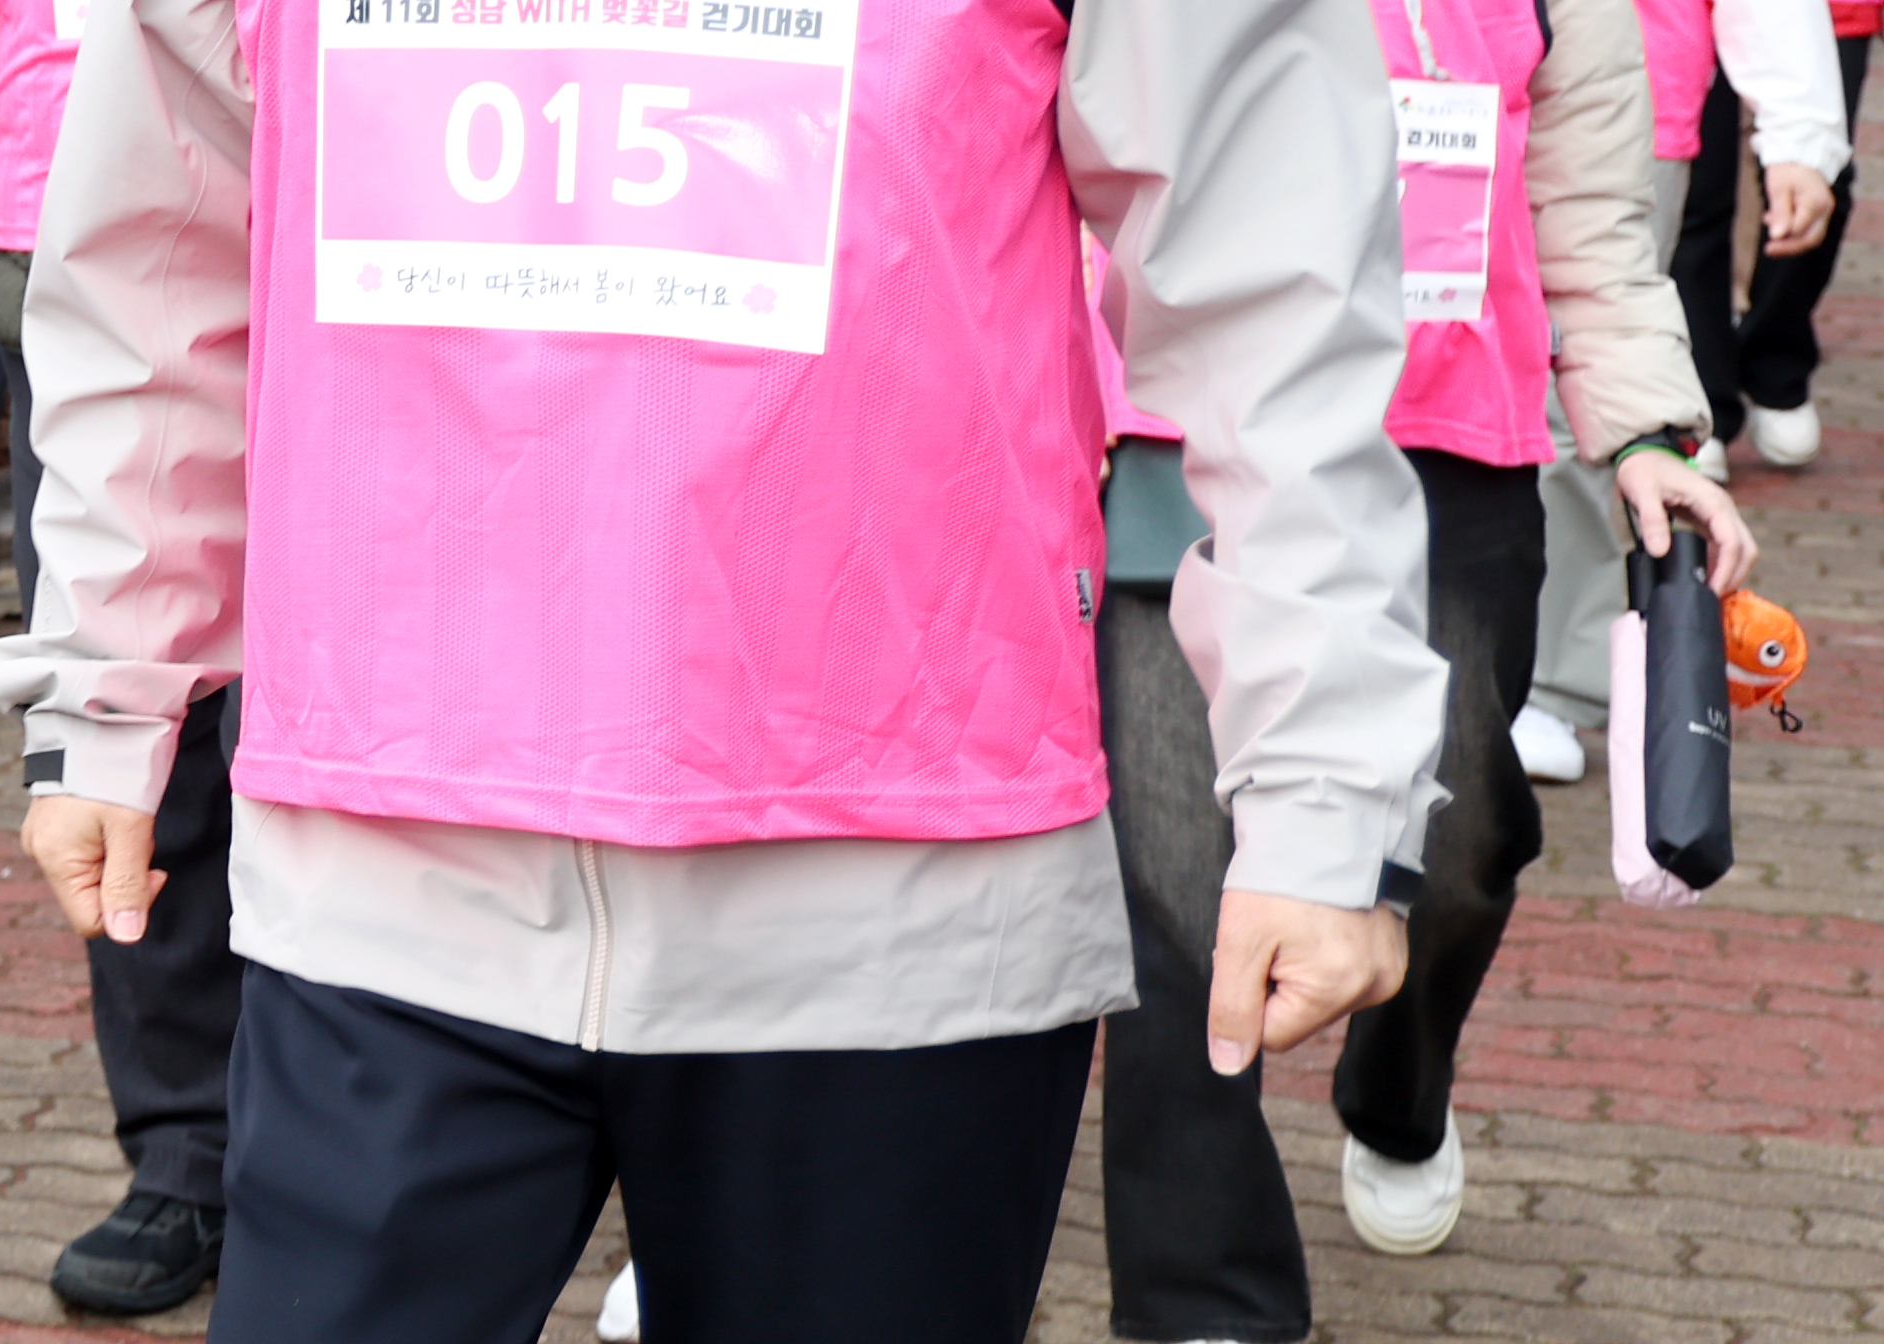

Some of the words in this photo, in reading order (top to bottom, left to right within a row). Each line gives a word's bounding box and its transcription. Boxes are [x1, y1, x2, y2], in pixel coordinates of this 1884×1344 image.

[702, 2, 825, 41] 걷기대회
[445, 81, 691, 207] 015
[1407, 129, 1477, 150] 걷기대회
[397, 266, 467, 295] 당신이
[485, 267, 581, 300] 따뜻해서
[594, 268, 636, 306] 봄이
[653, 275, 732, 308] 왔어요
